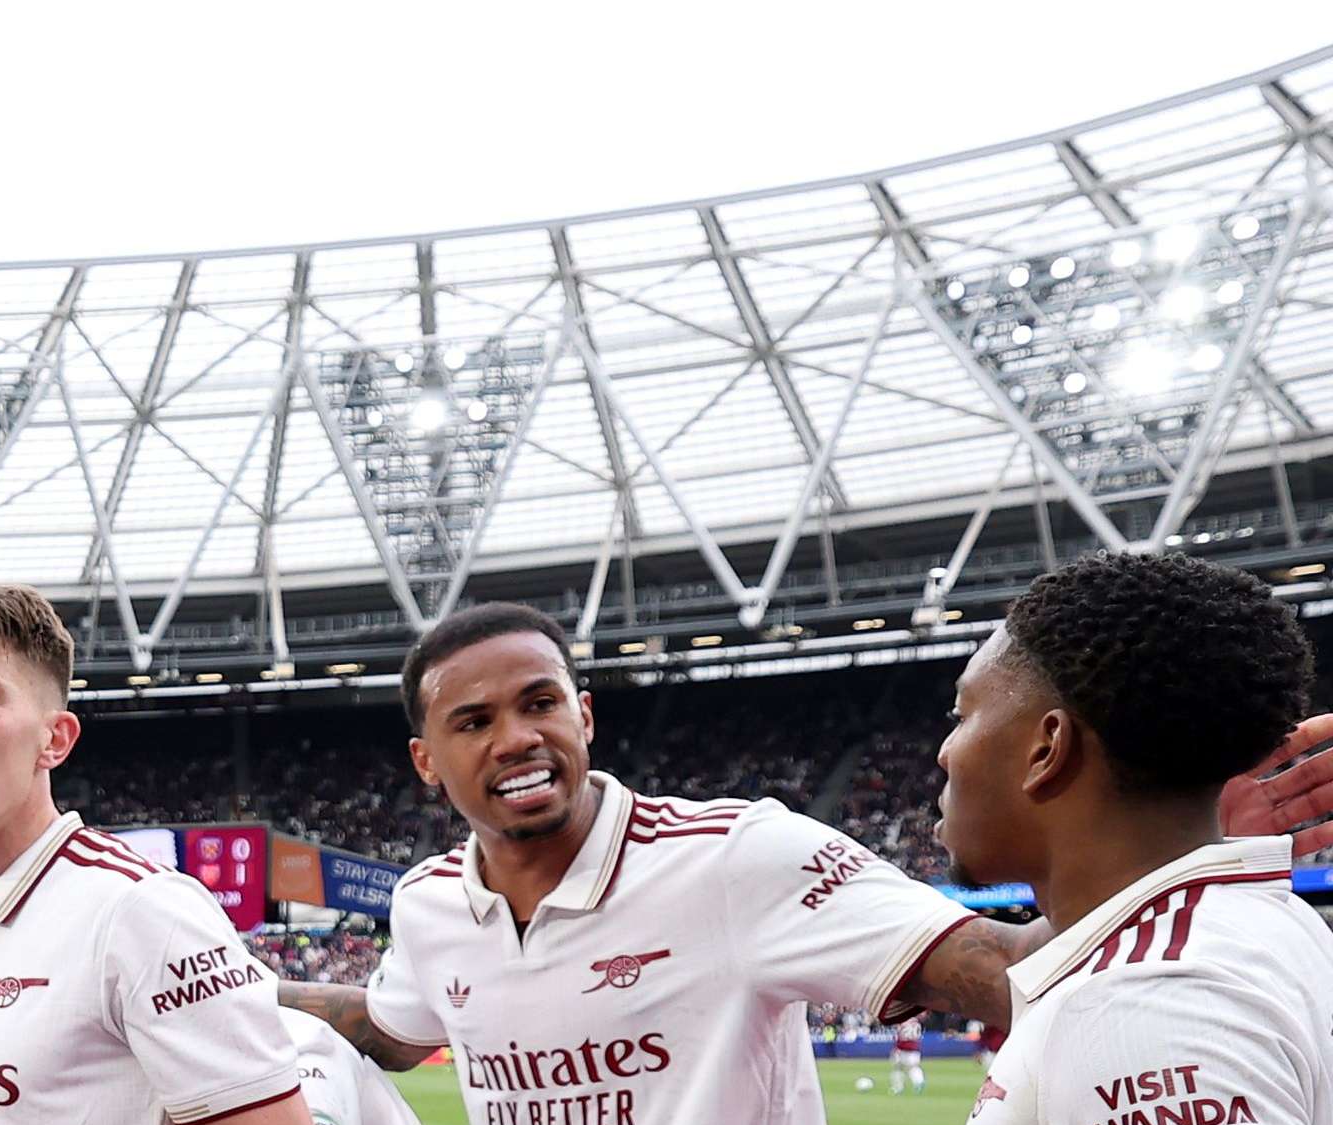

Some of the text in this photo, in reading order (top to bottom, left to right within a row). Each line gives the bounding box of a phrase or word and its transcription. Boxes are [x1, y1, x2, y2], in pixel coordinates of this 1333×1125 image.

[332, 860, 369, 881] STAY
[801, 851, 875, 911] RWAN
[167, 946, 229, 982] VISIT
[151, 964, 264, 1016] RWANDA
[462, 1032, 671, 1091] Emirates
[1095, 1065, 1200, 1111] VISIT
